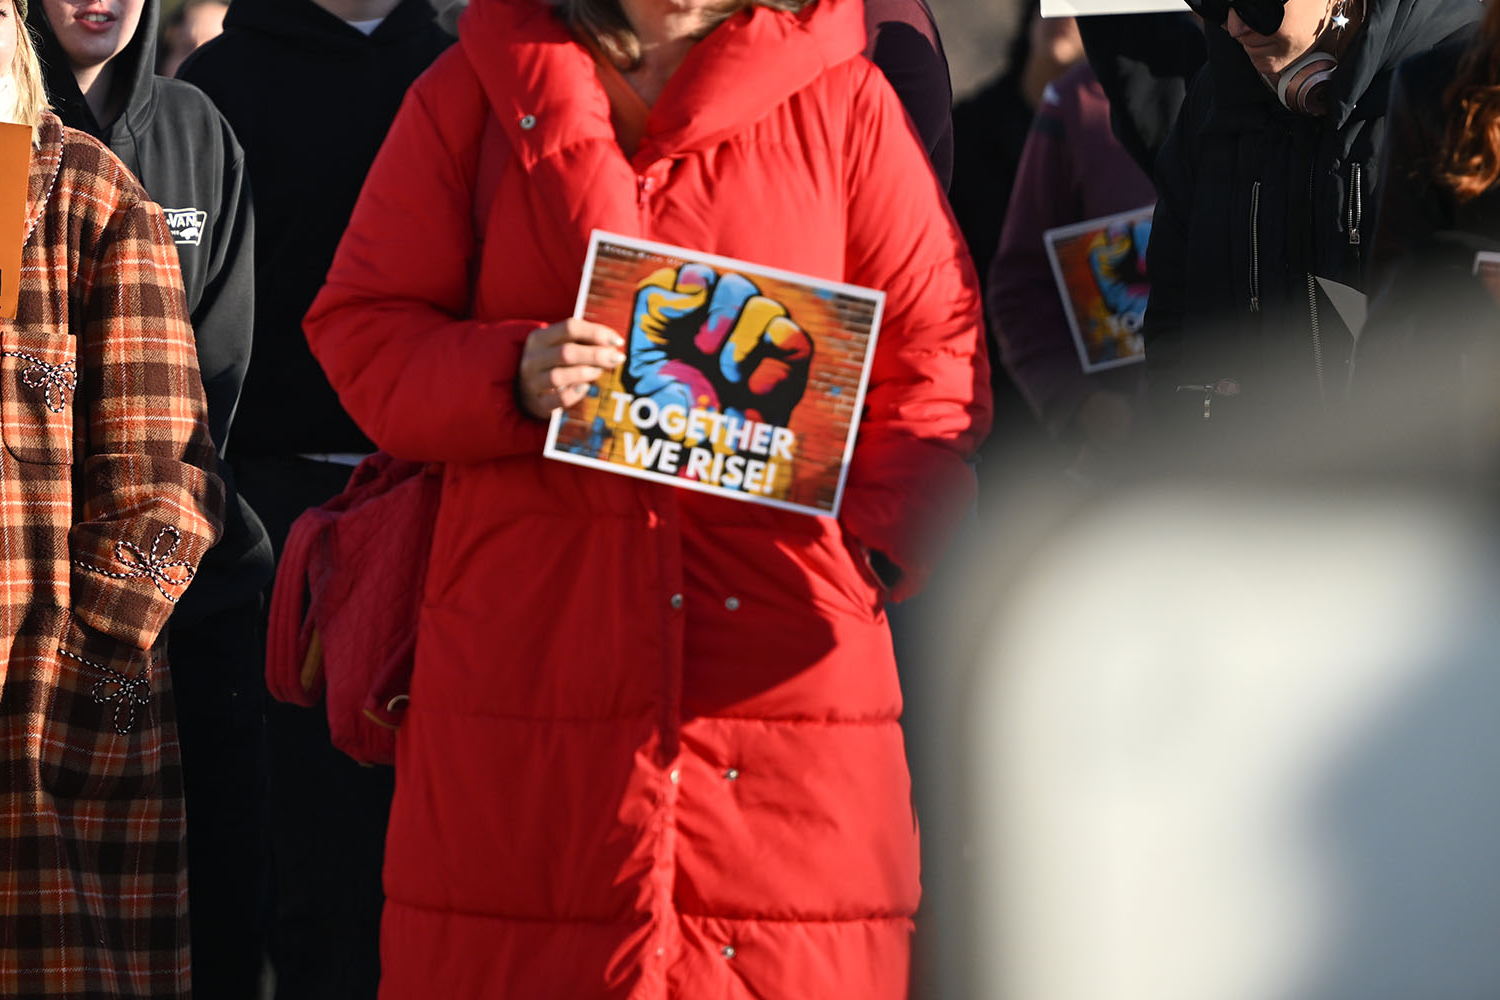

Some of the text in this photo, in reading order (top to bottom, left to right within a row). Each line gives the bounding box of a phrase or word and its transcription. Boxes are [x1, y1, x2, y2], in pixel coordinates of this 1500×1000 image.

[610, 390, 796, 461] TOGETHER
[622, 432, 779, 494] WE RISE!
